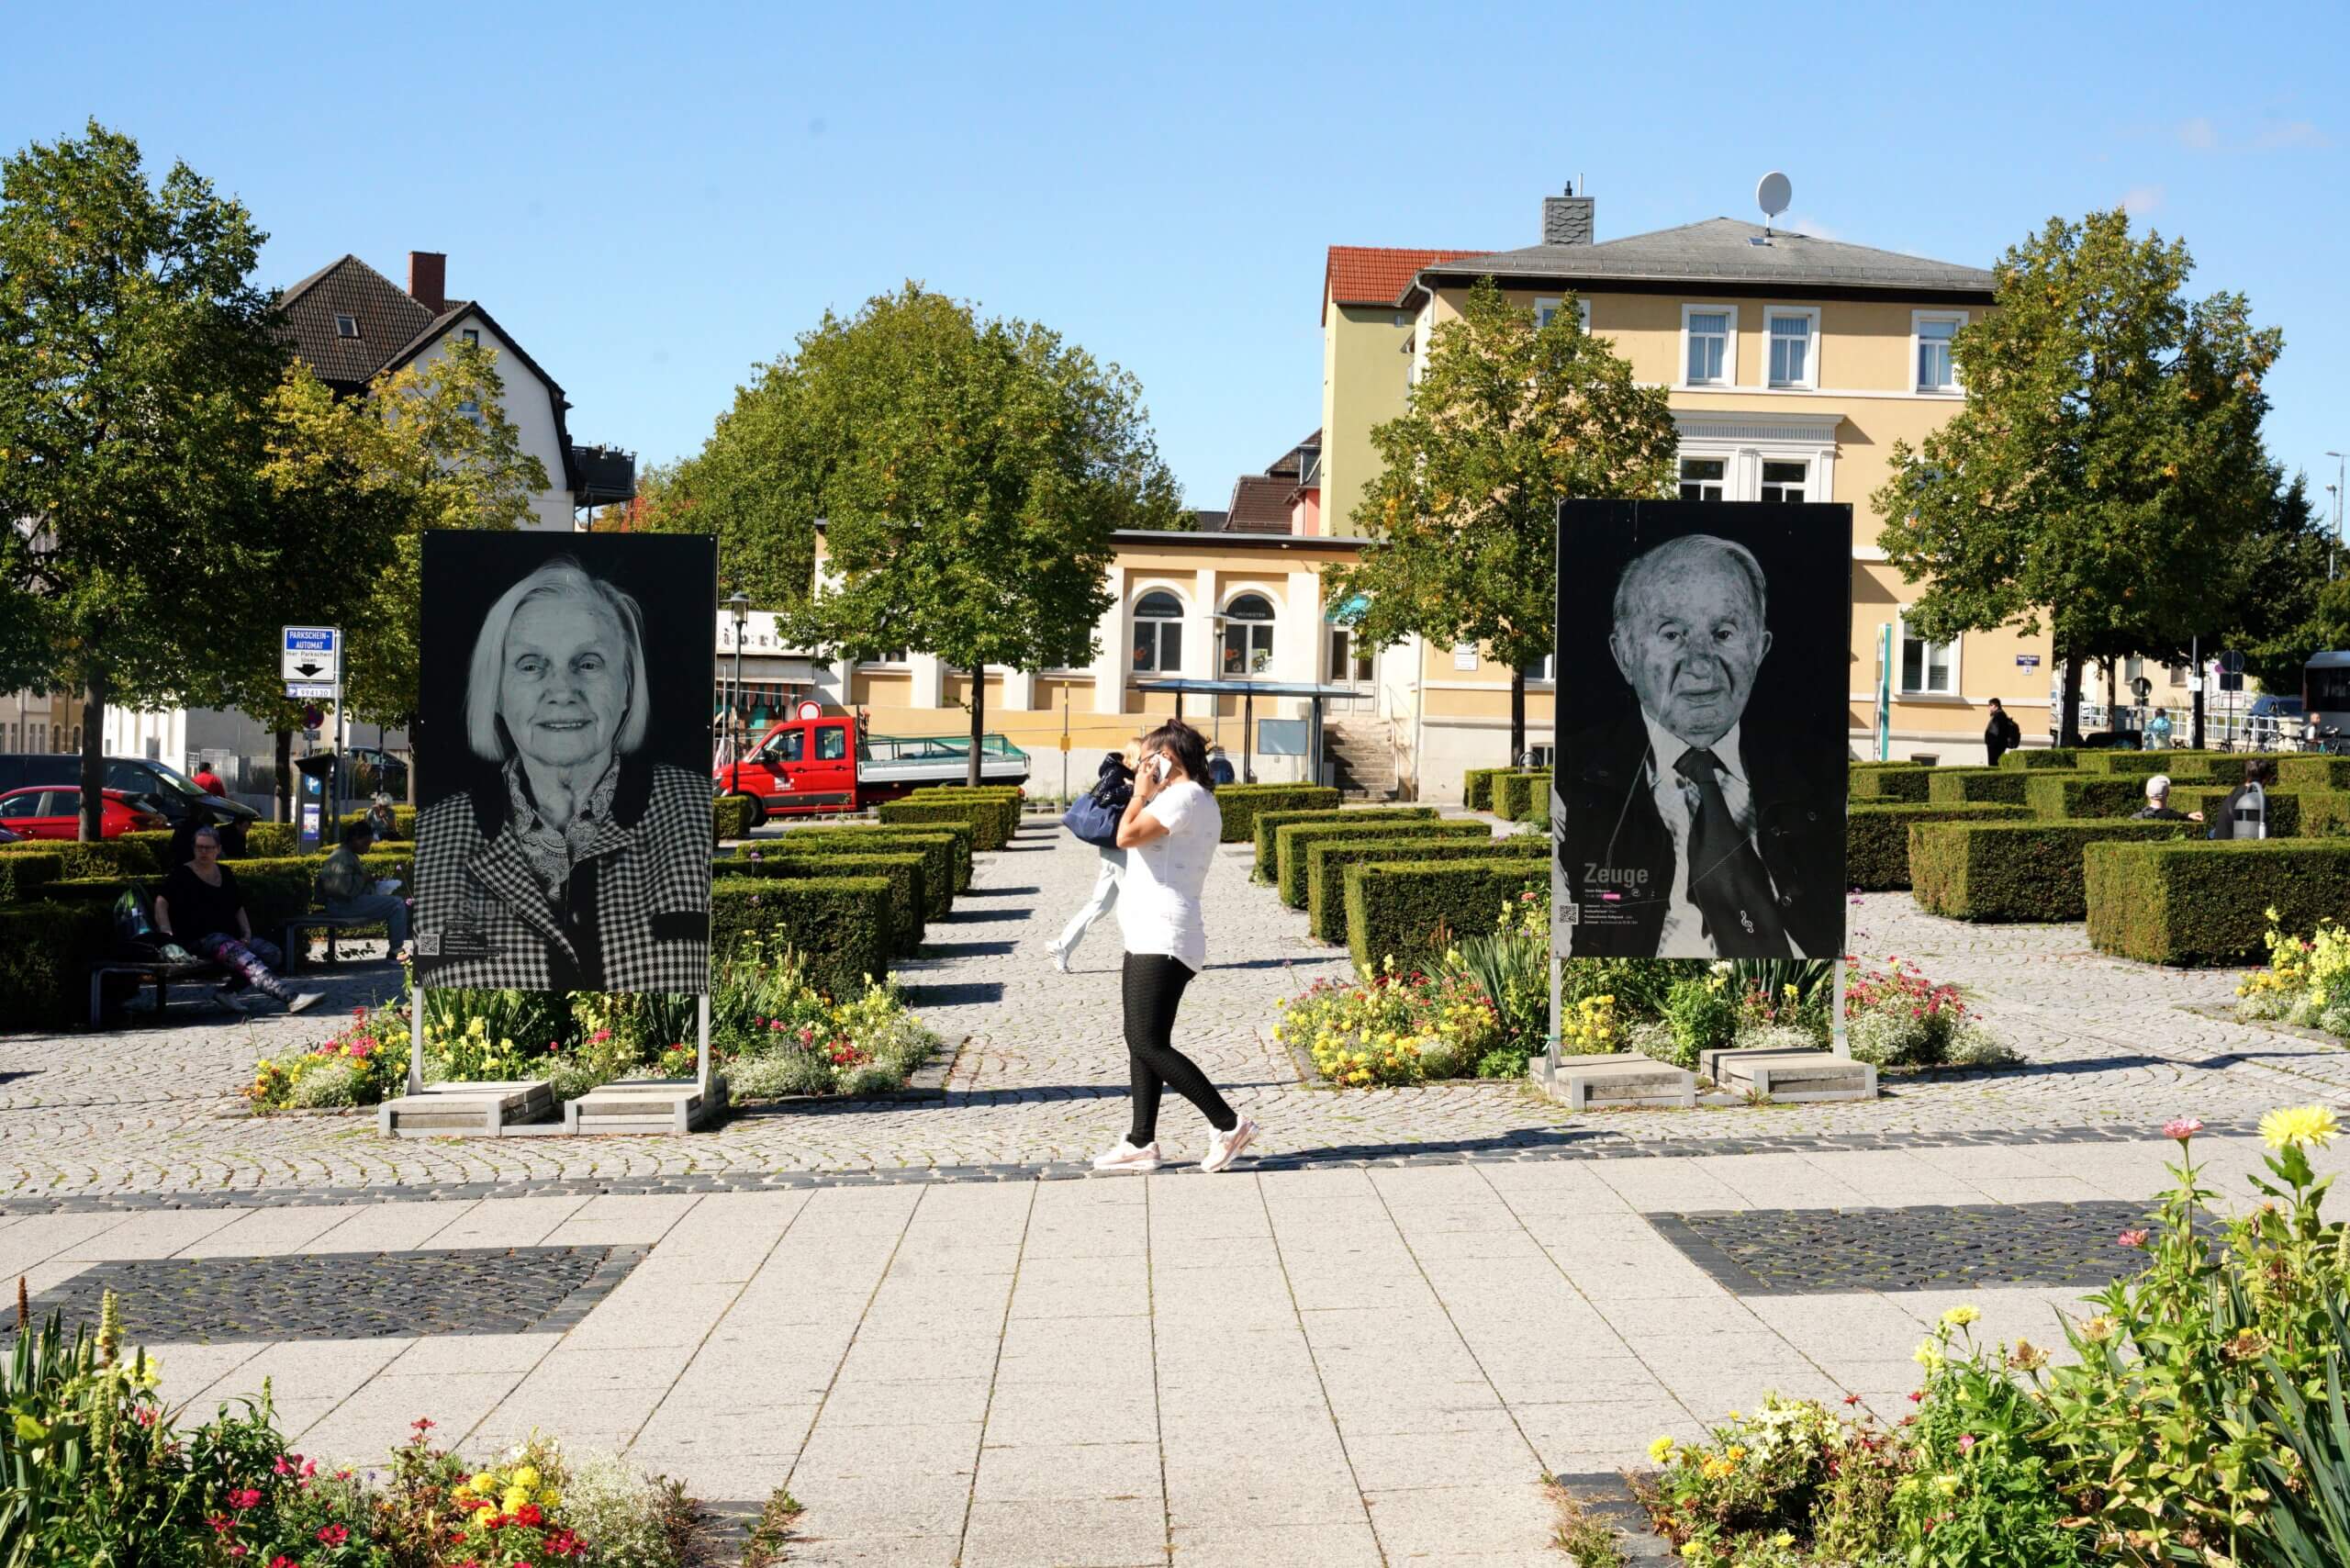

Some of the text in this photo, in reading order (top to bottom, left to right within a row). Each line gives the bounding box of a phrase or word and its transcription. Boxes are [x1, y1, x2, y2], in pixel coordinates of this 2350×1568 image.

[289, 631, 330, 640] PARKSCHEIN-
[296, 641, 323, 649] AUTOMAT
[1583, 862, 1649, 889] Zeuge
